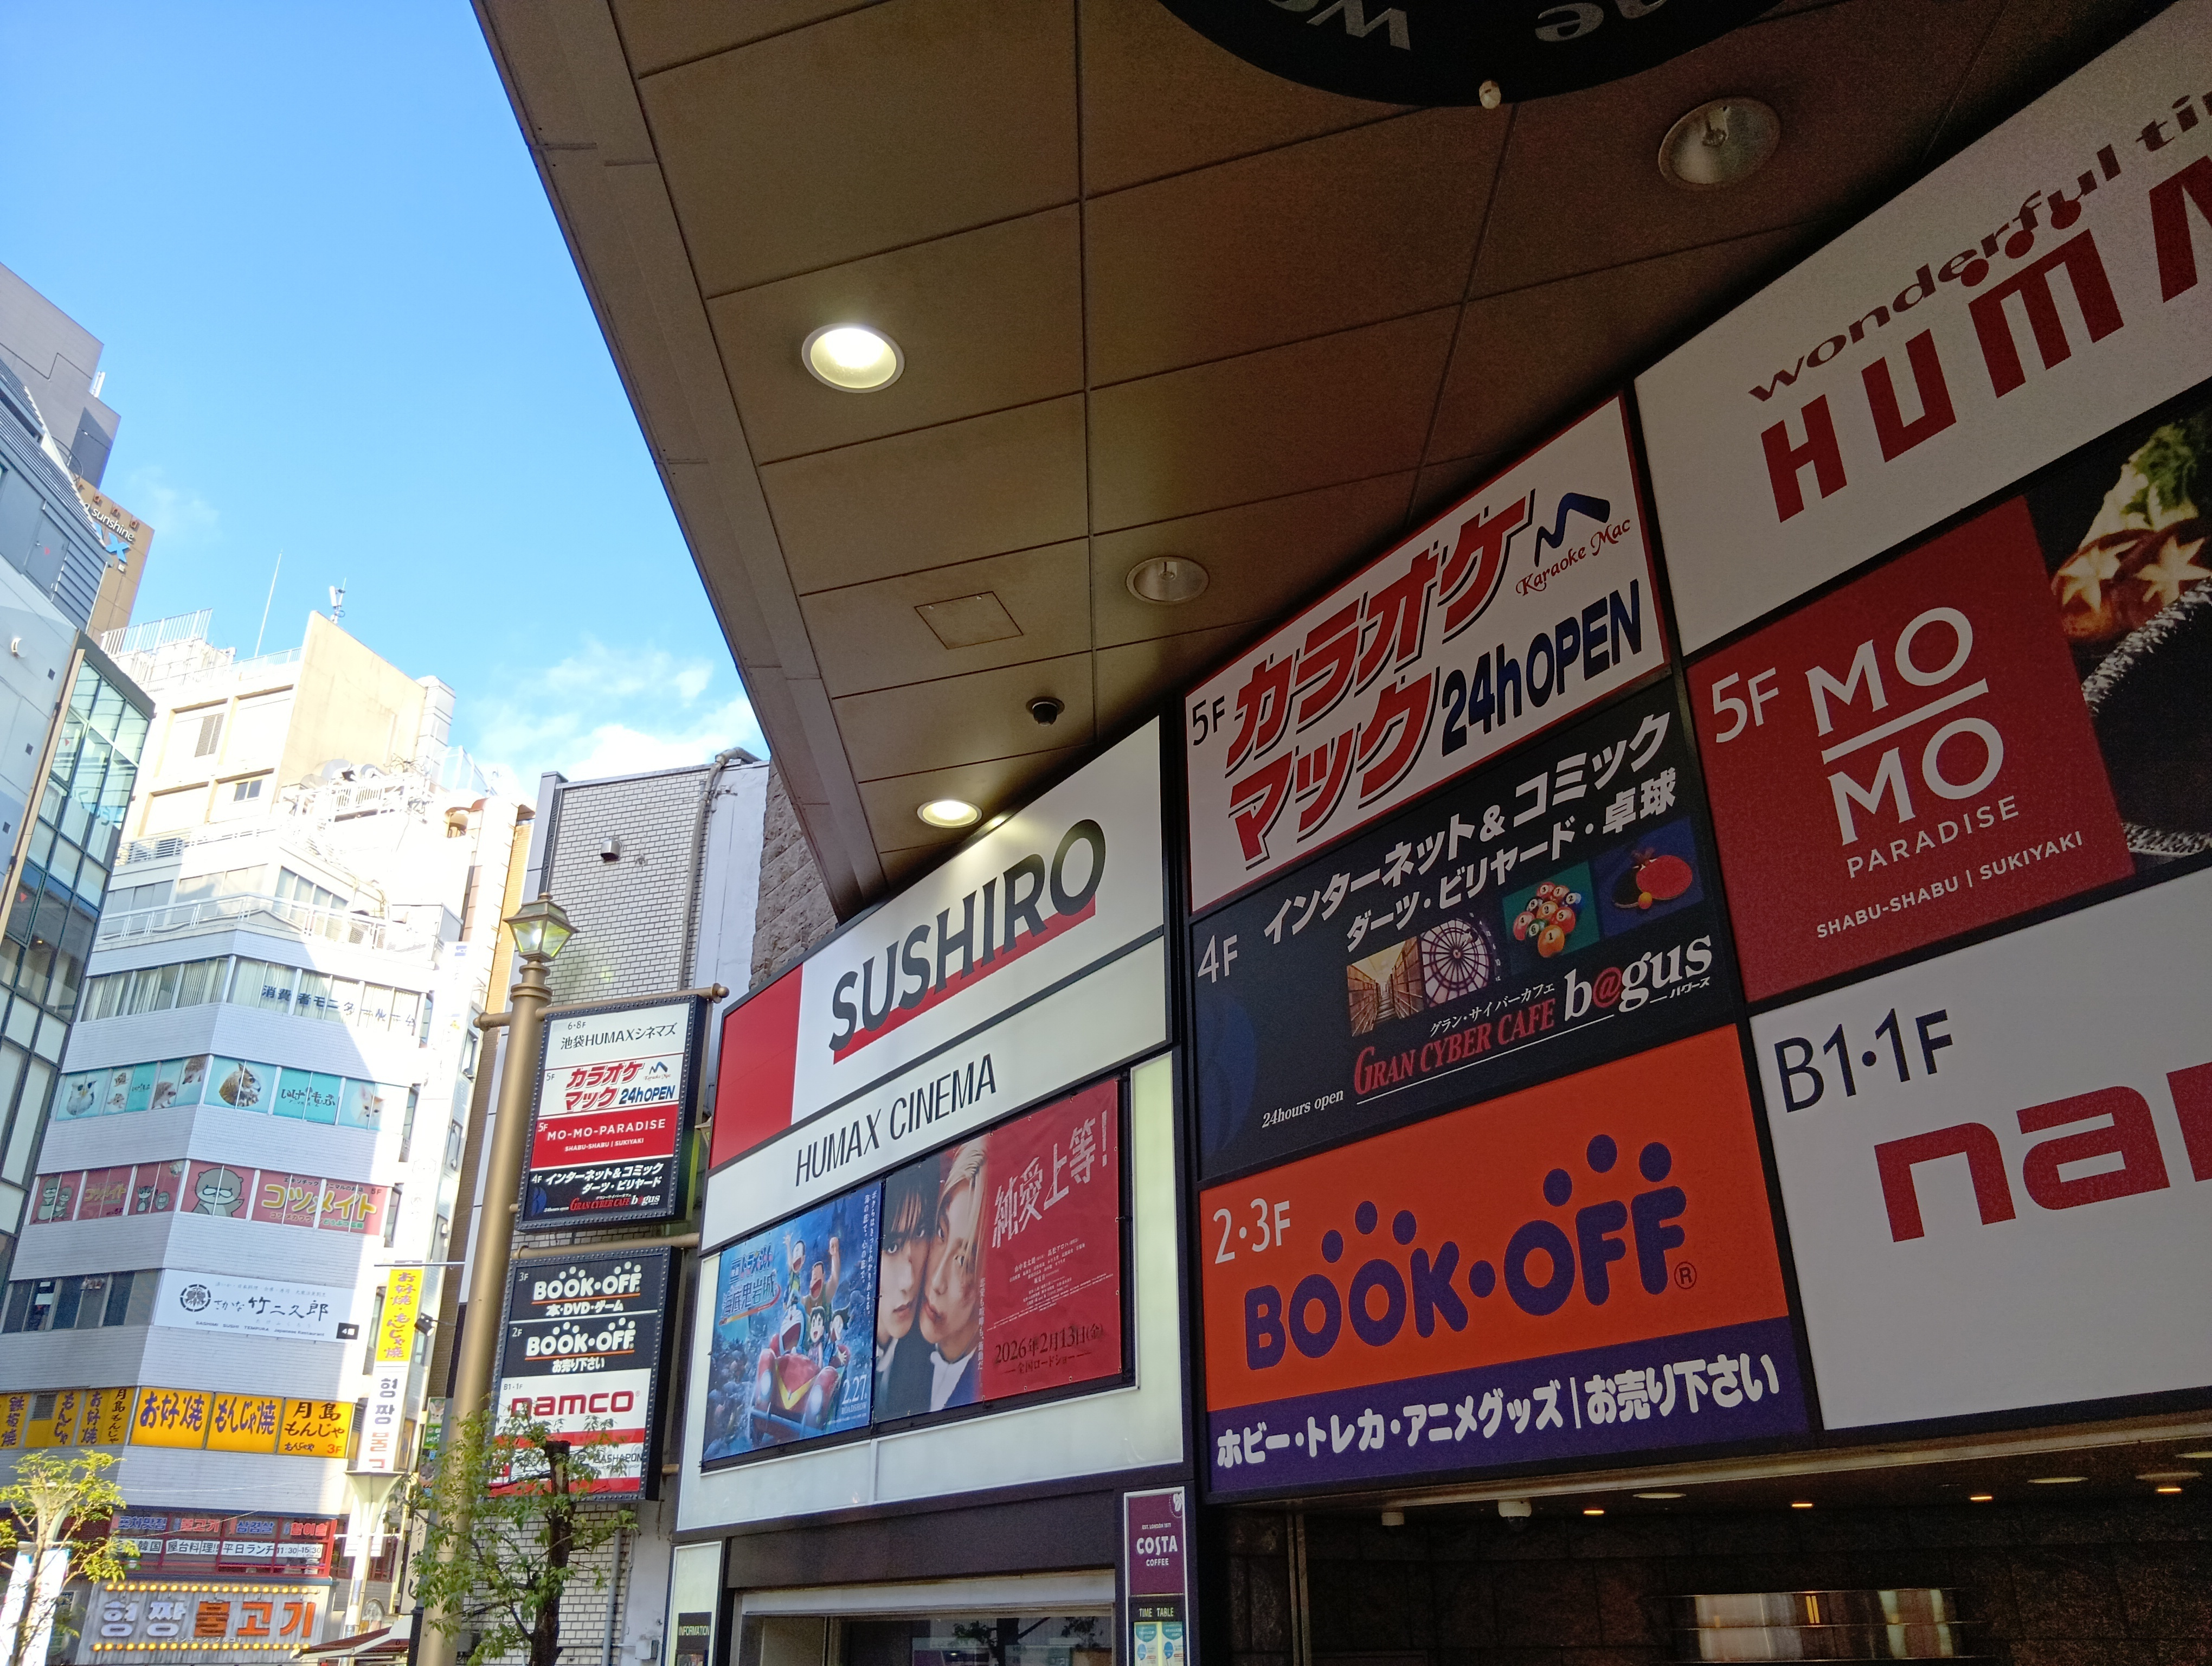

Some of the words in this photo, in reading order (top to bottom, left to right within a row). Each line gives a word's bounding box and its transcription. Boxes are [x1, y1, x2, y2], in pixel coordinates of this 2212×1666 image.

[1748, 143, 2121, 402] wonderful
[2136, 90, 2212, 152] ti
[92, 508, 134, 542] sunshine
[1516, 544, 1586, 595] Karaoke
[1591, 520, 1631, 556] Mac
[1225, 489, 1535, 778] カラオケ
[1804, 607, 1973, 737] MO
[1711, 667, 1779, 743] 5F
[1193, 696, 1226, 746] 5F
[1229, 667, 1439, 870] マック
[1827, 717, 2004, 845] MO
[1263, 712, 1671, 944] インターネット&コミック
[1847, 795, 2019, 879] PARADISE
[1816, 876, 1959, 939] SHABU-SHABU
[1979, 830, 2083, 880] SUKIYAKI
[829, 819, 1106, 1052] SUSHIRO
[1197, 932, 1239, 983] 4F
[1354, 1047, 1414, 1095] GRAN
[1420, 1027, 1491, 1072] CYBER
[1497, 998, 1555, 1041] CAFE
[1564, 935, 1713, 1021] b@gus
[561, 1022, 678, 1050] 池袋HUMAXシネマズ
[546, 1073, 555, 1081] 5F
[565, 1061, 645, 1090] カラオケ
[565, 1086, 619, 1112] マック
[1262, 1098, 1310, 1127] 24hours
[1314, 1090, 1344, 1112] open
[538, 1122, 548, 1132] 5F
[547, 1119, 666, 1141] MO-MO-PARADISE
[795, 1108, 881, 1187] HUMAX
[890, 1053, 997, 1140] CINEMA
[565, 1141, 609, 1151] SHABU-SHABU
[615, 1138, 644, 1146] SUKIYAKI
[532, 1173, 542, 1183] 4F
[546, 1162, 664, 1186] インターネット&コミック
[519, 1272, 529, 1281] 3F
[546, 1299, 623, 1317] 本・DVD・ゲーム
[512, 1328, 522, 1337] 2F
[552, 1357, 605, 1373] お売り下さい
[139, 1391, 204, 1432] お好焼
[215, 1396, 276, 1435] もんじゃ焼
[293, 1402, 342, 1420] 月島
[511, 1391, 634, 1418] namco
[285, 1422, 345, 1438] もんじゃ
[327, 1444, 342, 1454] 3F
[1136, 1535, 1178, 1555] COSTA
[1146, 1558, 1169, 1566] COFFEE
[1139, 1608, 1152, 1617] TIME
[1157, 1607, 1174, 1617] TABLE
[678, 1625, 710, 1636] INFORMATION
